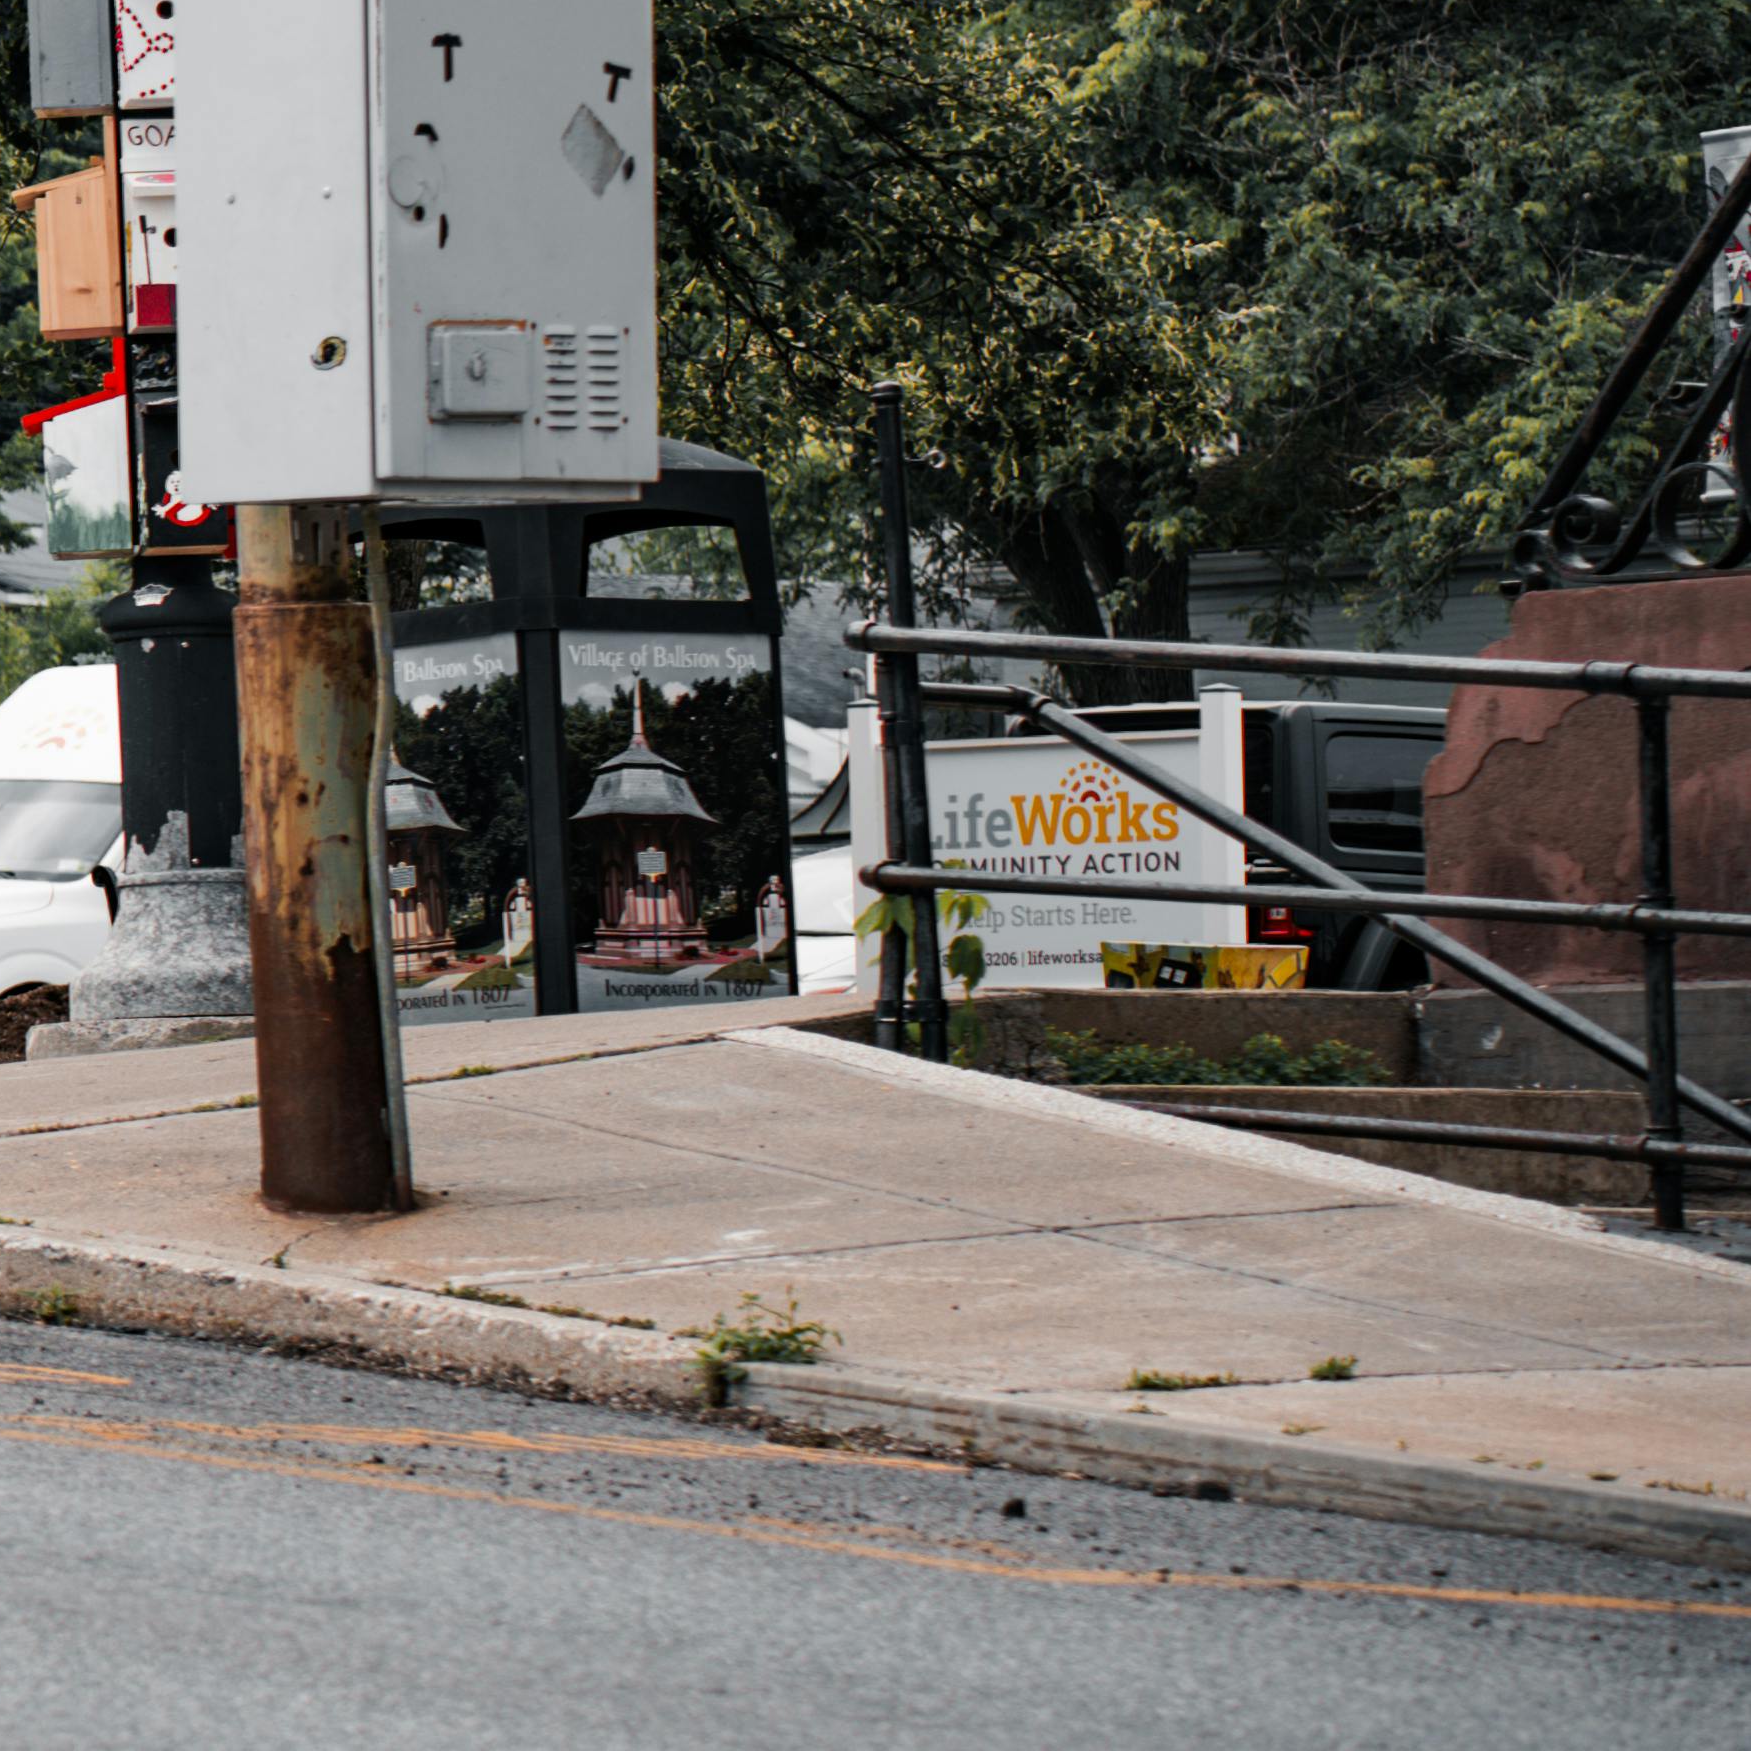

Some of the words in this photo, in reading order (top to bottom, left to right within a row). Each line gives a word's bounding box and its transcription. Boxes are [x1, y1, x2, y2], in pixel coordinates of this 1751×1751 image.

[473, 653, 505, 680] Spa
[569, 644, 625, 672] Village
[630, 645, 648, 668] of
[653, 645, 721, 668] Ballston
[726, 647, 756, 673] Spa
[1082, 851, 1181, 874] ACTION
[1011, 904, 1075, 928] Starts
[1081, 902, 1137, 925] Here.
[1027, 949, 1104, 966] lifeworksa
[471, 983, 511, 1005] 1807
[605, 979, 699, 1000] Incorporated
[725, 979, 765, 996] 1807
